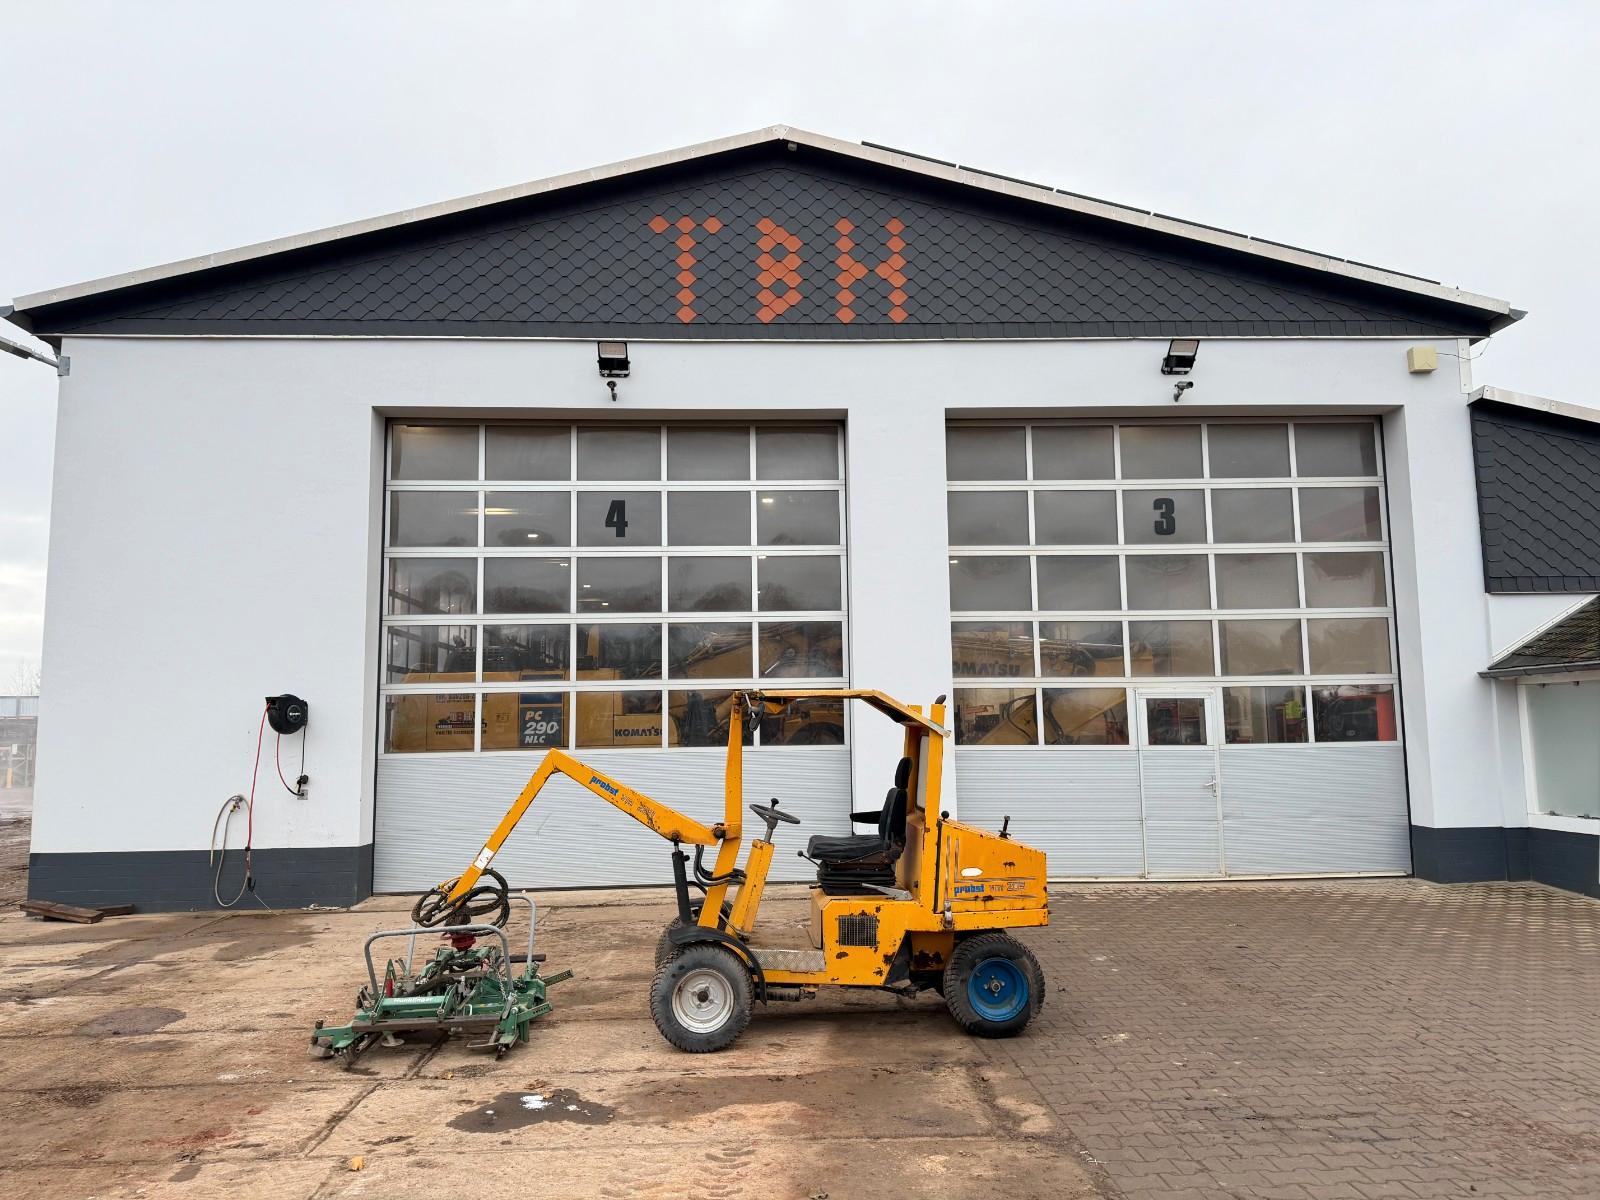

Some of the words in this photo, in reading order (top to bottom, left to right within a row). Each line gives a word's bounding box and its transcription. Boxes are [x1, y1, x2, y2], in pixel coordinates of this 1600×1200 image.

[649, 215, 908, 324] TBH
[605, 499, 628, 537] 4
[1153, 498, 1175, 535] 3
[952, 661, 1020, 677] OMATSU
[525, 711, 543, 720] PC
[524, 721, 558, 734] 290
[614, 727, 662, 737] KOMATS
[524, 735, 545, 743] NLC
[589, 776, 618, 796] probst
[954, 883, 984, 897] probst
